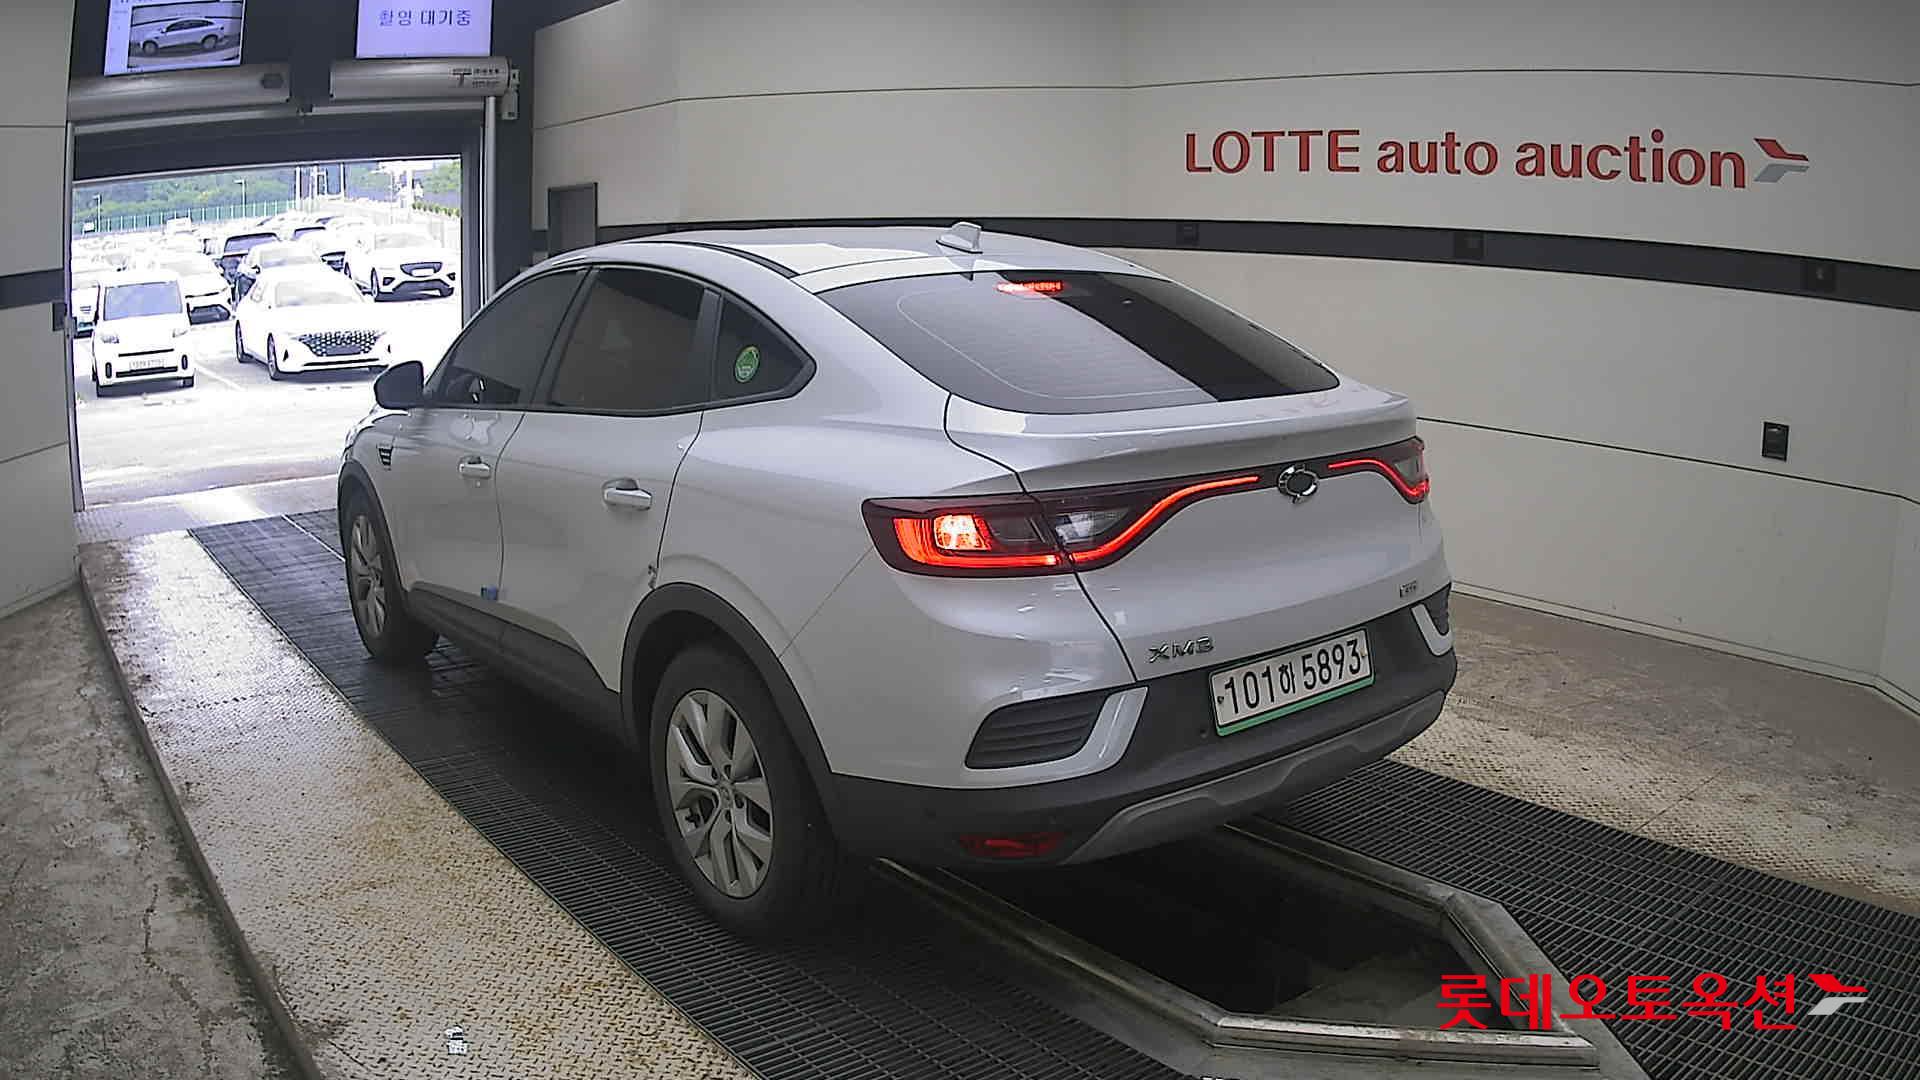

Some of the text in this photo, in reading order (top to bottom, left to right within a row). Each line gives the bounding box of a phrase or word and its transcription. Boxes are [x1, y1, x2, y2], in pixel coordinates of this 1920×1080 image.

[420, 9, 471, 26] 대기중
[1185, 128, 1746, 188] LOTTE auto auction
[1302, 639, 1362, 690] 5893
